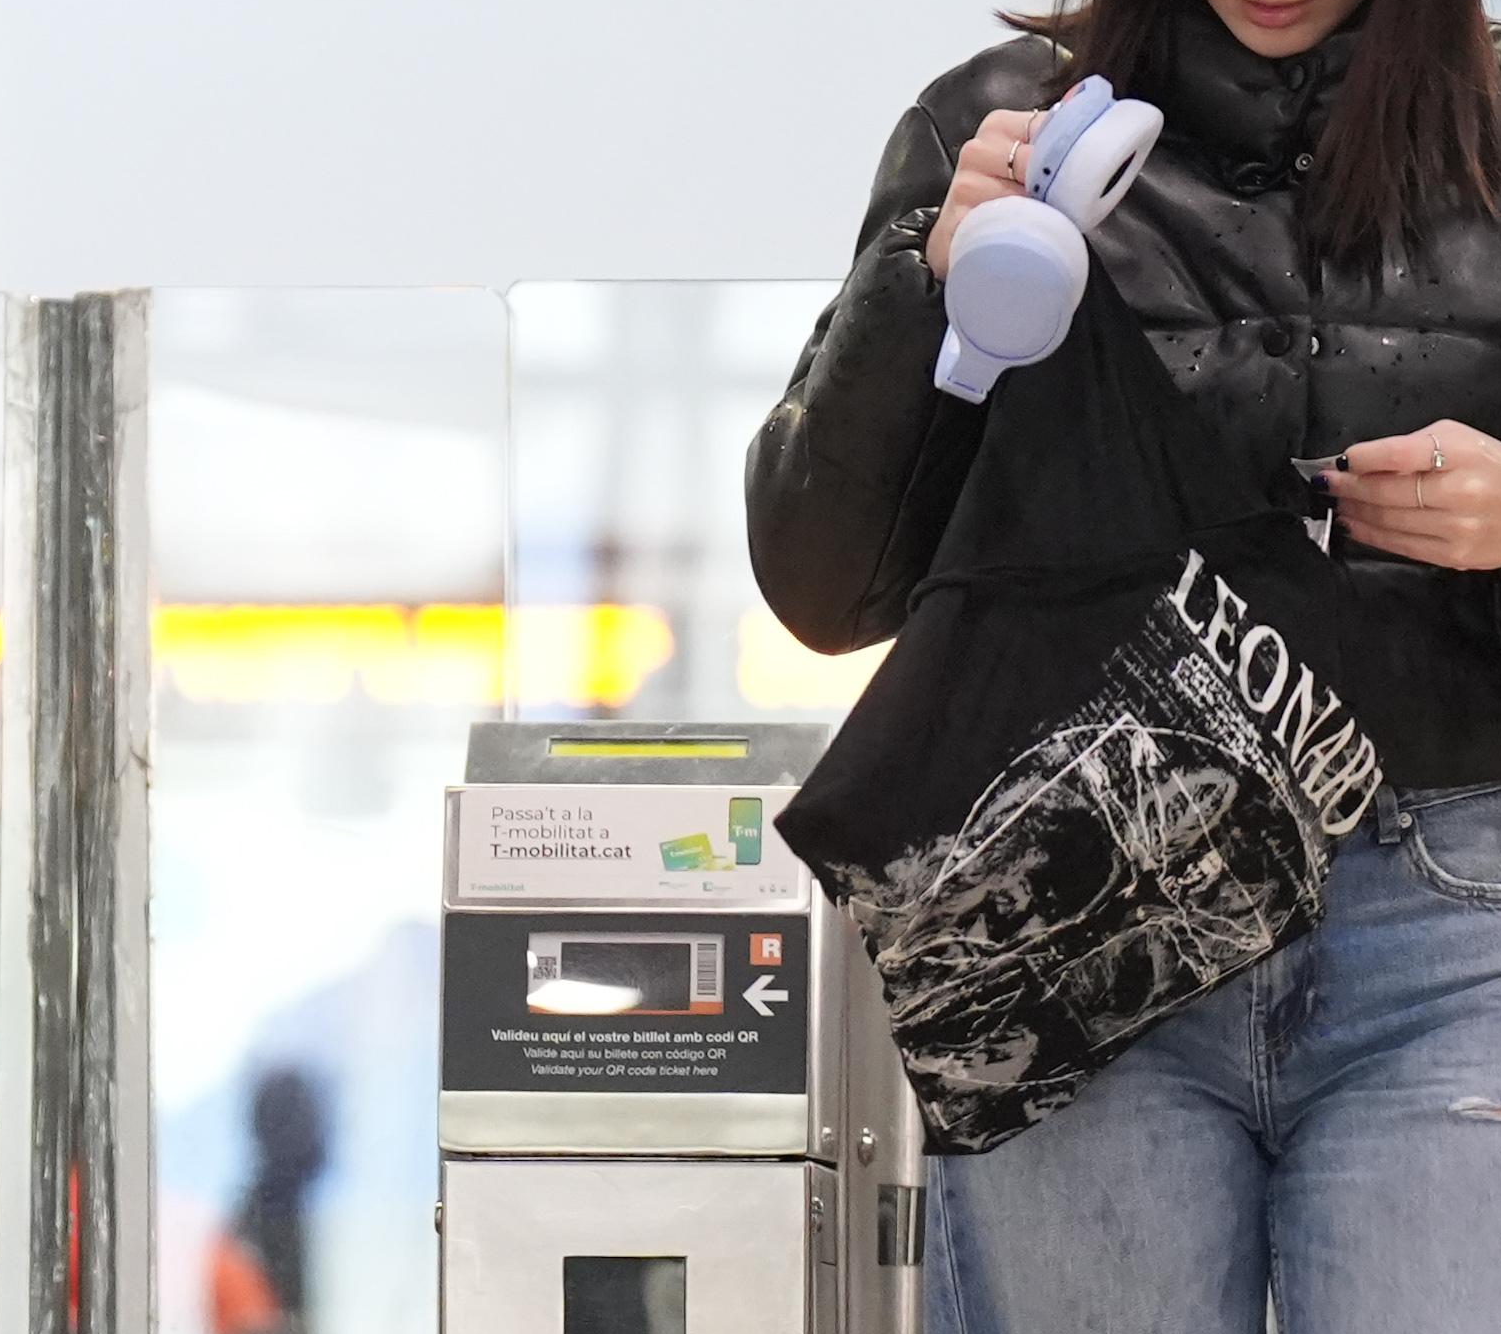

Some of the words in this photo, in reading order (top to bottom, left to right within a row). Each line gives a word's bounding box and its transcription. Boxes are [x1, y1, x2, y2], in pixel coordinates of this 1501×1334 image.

[491, 806, 556, 821] Passa't
[562, 810, 572, 821] a
[578, 806, 593, 821] la
[491, 824, 594, 840] T-mobilitat
[599, 828, 610, 839] a
[490, 842, 632, 859] T-mobilitat.cat
[761, 938, 782, 958] R
[491, 1029, 539, 1042] Valideu
[542, 1029, 571, 1044] aquí
[574, 1031, 586, 1043] el
[589, 1032, 631, 1043] vostre
[633, 1031, 671, 1043] bitllet
[674, 1031, 703, 1043] amb
[706, 1031, 734, 1043] codi
[737, 1030, 759, 1043] QR
[523, 1047, 558, 1058] Valide
[588, 1049, 602, 1059] su
[604, 1048, 639, 1059] billete
[641, 1050, 663, 1059] con
[707, 1048, 727, 1059] QR
[531, 1064, 576, 1075] Validate
[577, 1066, 603, 1077] your
[606, 1064, 625, 1075] QR
[627, 1065, 657, 1076] code
[659, 1065, 690, 1076] ticket
[693, 1065, 718, 1076] here
